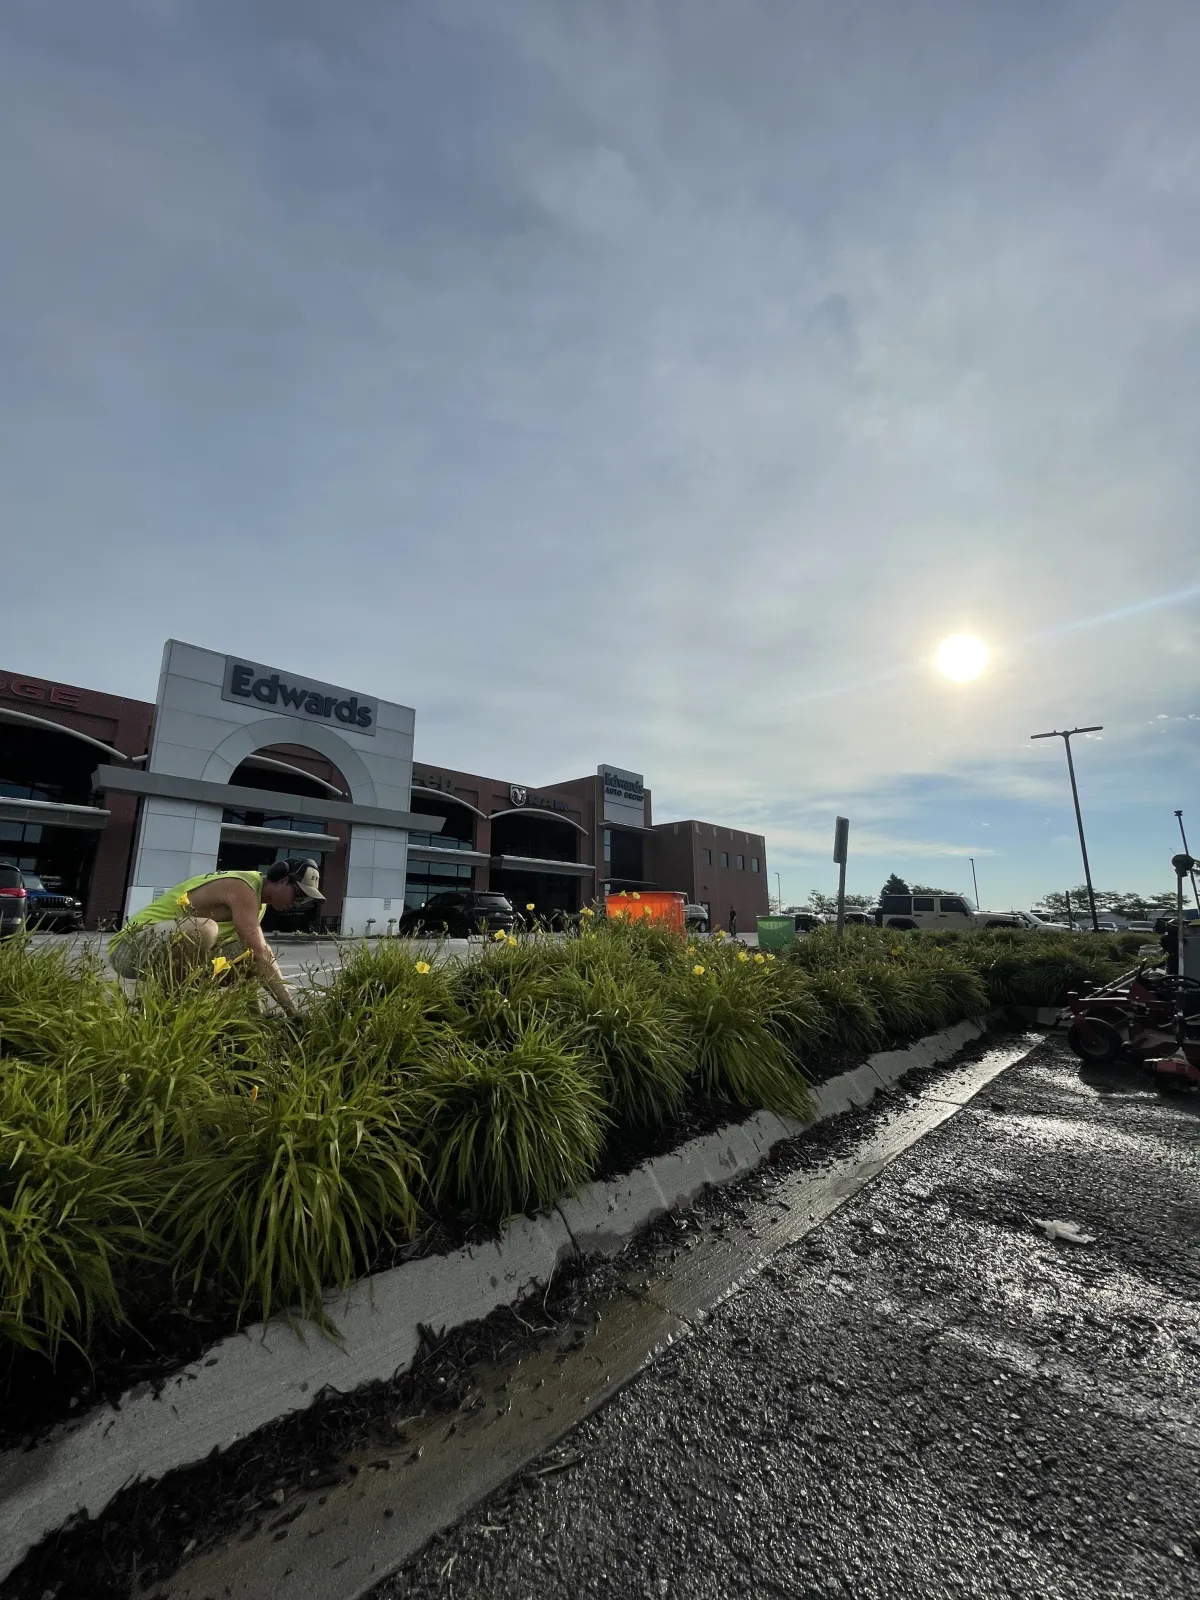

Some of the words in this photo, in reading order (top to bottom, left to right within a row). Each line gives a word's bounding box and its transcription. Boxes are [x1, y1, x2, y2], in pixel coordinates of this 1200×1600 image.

[0, 677, 82, 709] GE
[231, 664, 373, 728] Edwards
[605, 773, 644, 794] Edwards
[527, 795, 569, 811] RAM
[606, 787, 623, 797] AUTO
[624, 792, 644, 802] GROUP
